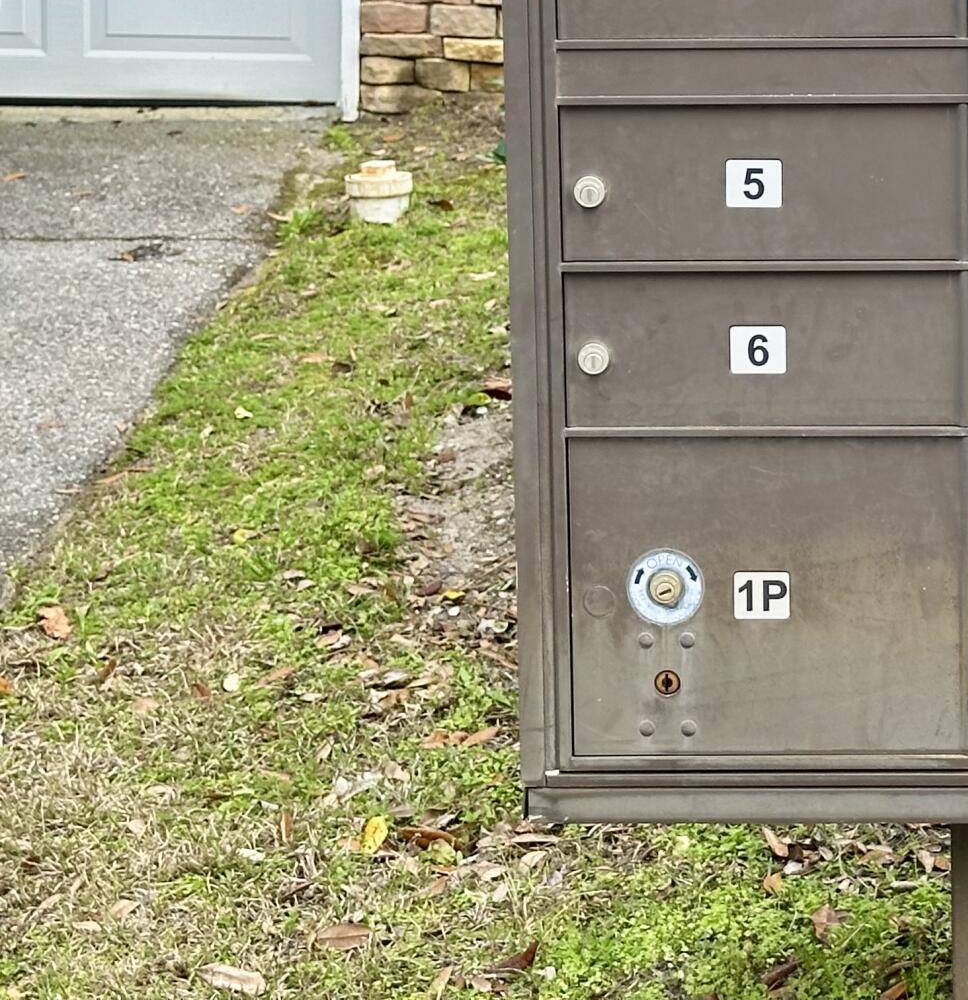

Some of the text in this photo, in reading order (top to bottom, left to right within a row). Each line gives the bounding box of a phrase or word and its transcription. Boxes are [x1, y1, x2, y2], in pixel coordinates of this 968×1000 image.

[743, 167, 765, 200] 5
[747, 334, 770, 367] 6
[647, 554, 684, 570] OPEN
[738, 579, 788, 612] 1P
